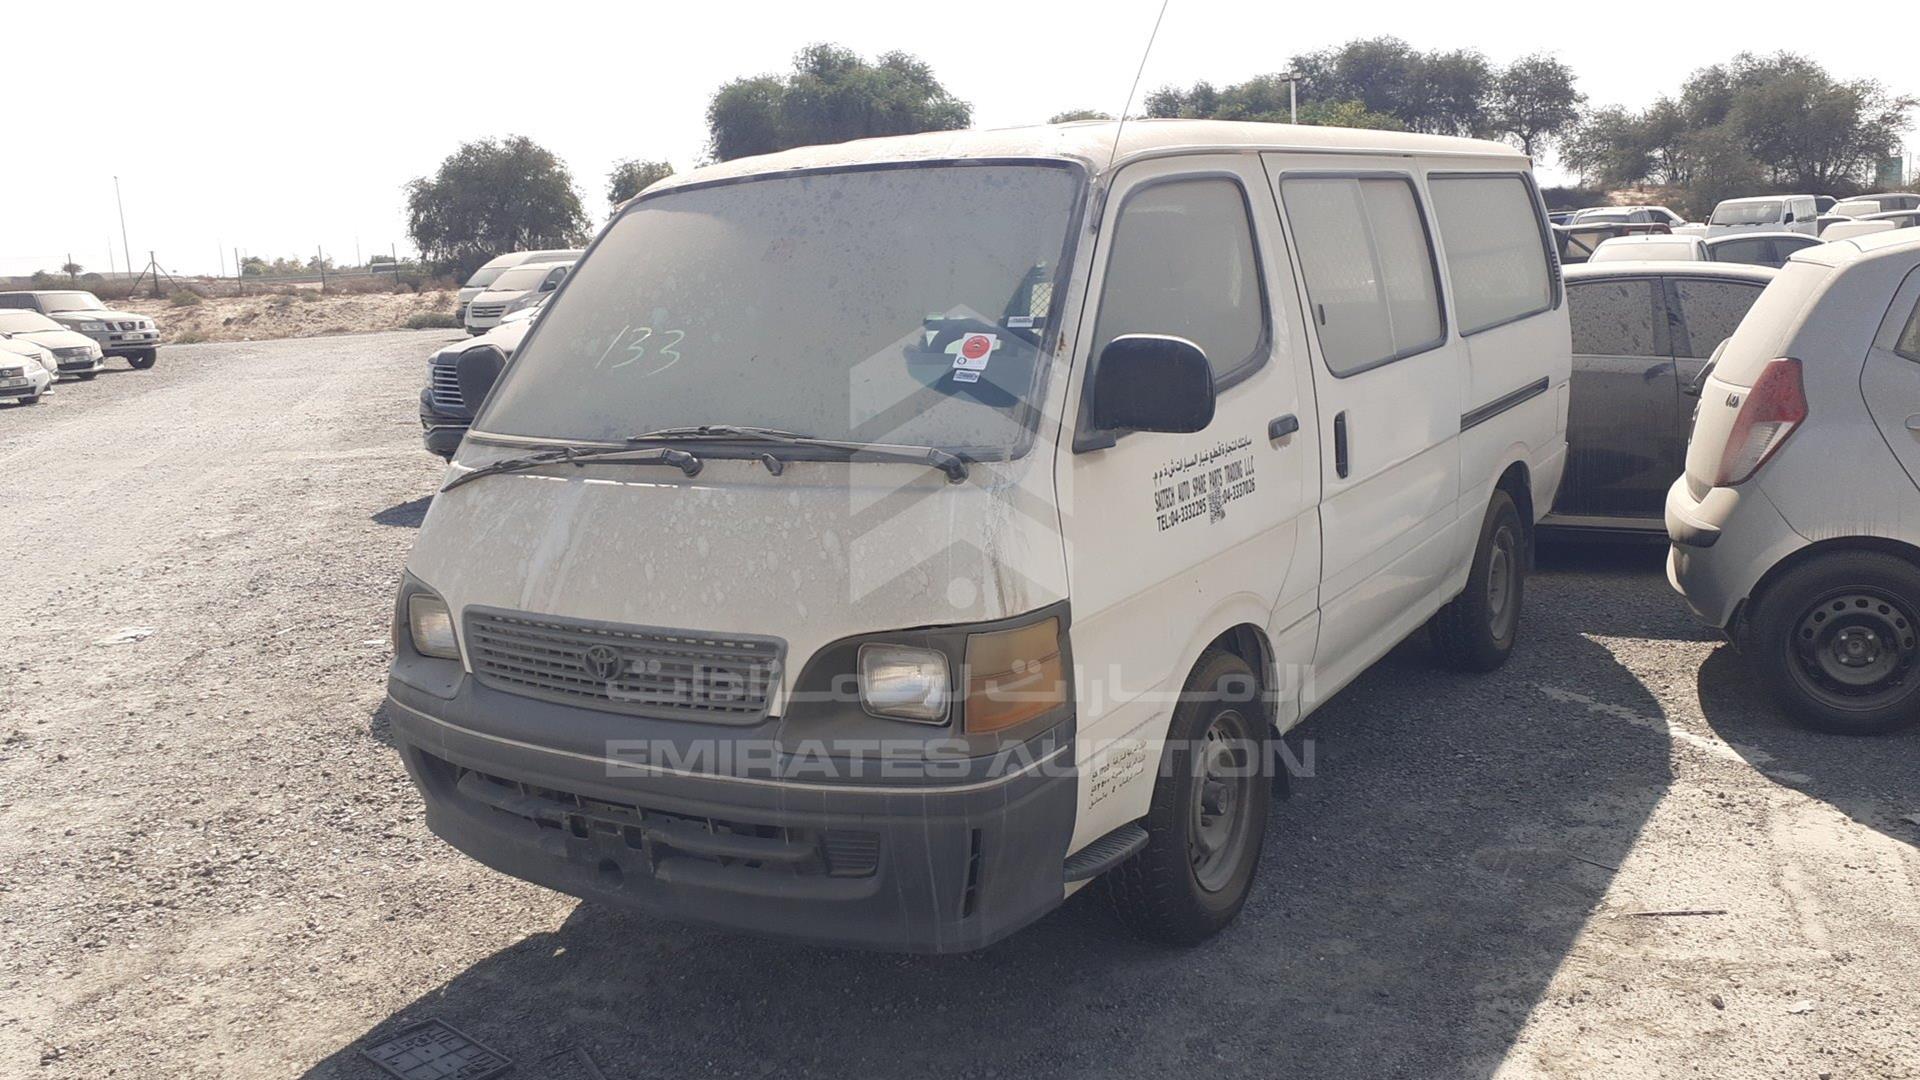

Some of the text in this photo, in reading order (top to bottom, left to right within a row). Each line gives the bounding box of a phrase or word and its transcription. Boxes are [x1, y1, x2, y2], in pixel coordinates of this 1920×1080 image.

[594, 324, 685, 376] 133
[1177, 480, 1190, 503] AUTO
[1192, 473, 1207, 498] SPARE
[1208, 467, 1223, 491] PARTS
[1224, 459, 1243, 484] TRADING
